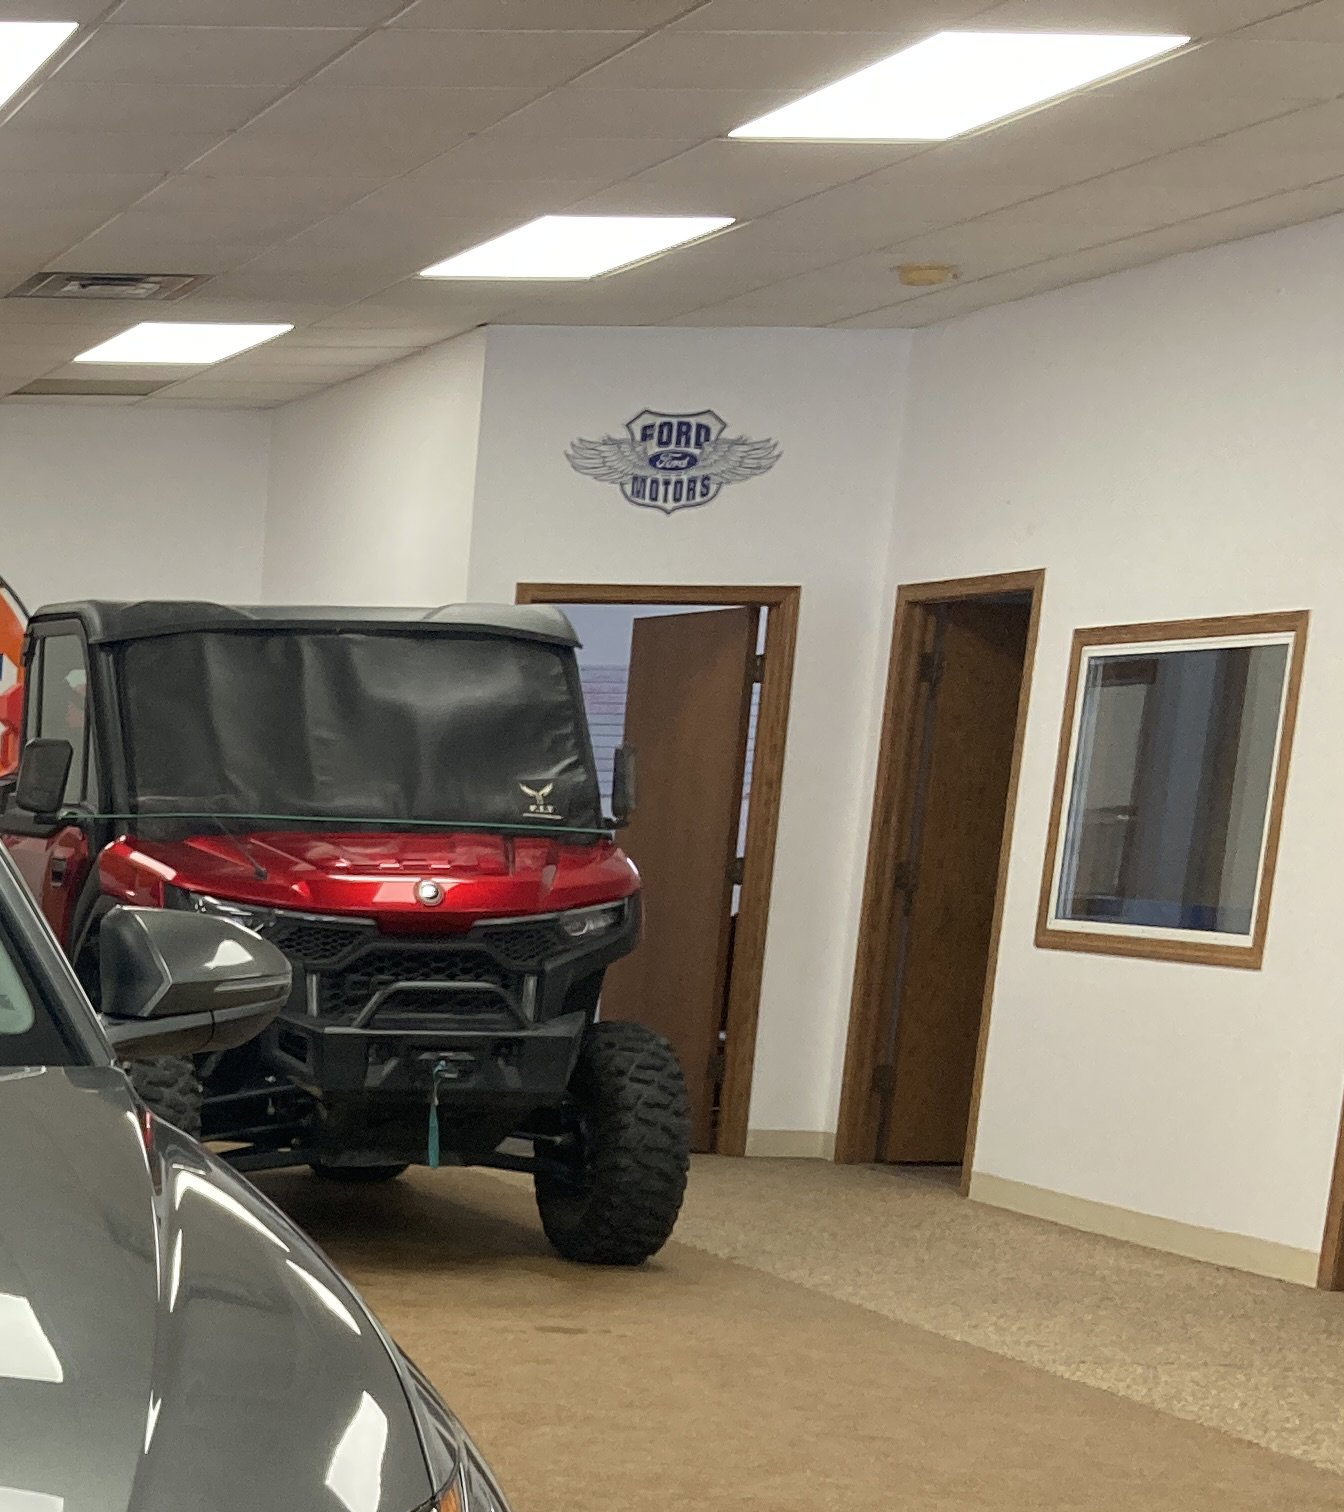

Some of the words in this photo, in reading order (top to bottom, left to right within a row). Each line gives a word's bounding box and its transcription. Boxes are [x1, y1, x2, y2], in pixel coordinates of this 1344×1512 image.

[640, 421, 711, 449] FORD
[656, 454, 689, 468] Ford
[631, 474, 711, 503] MOTORS
